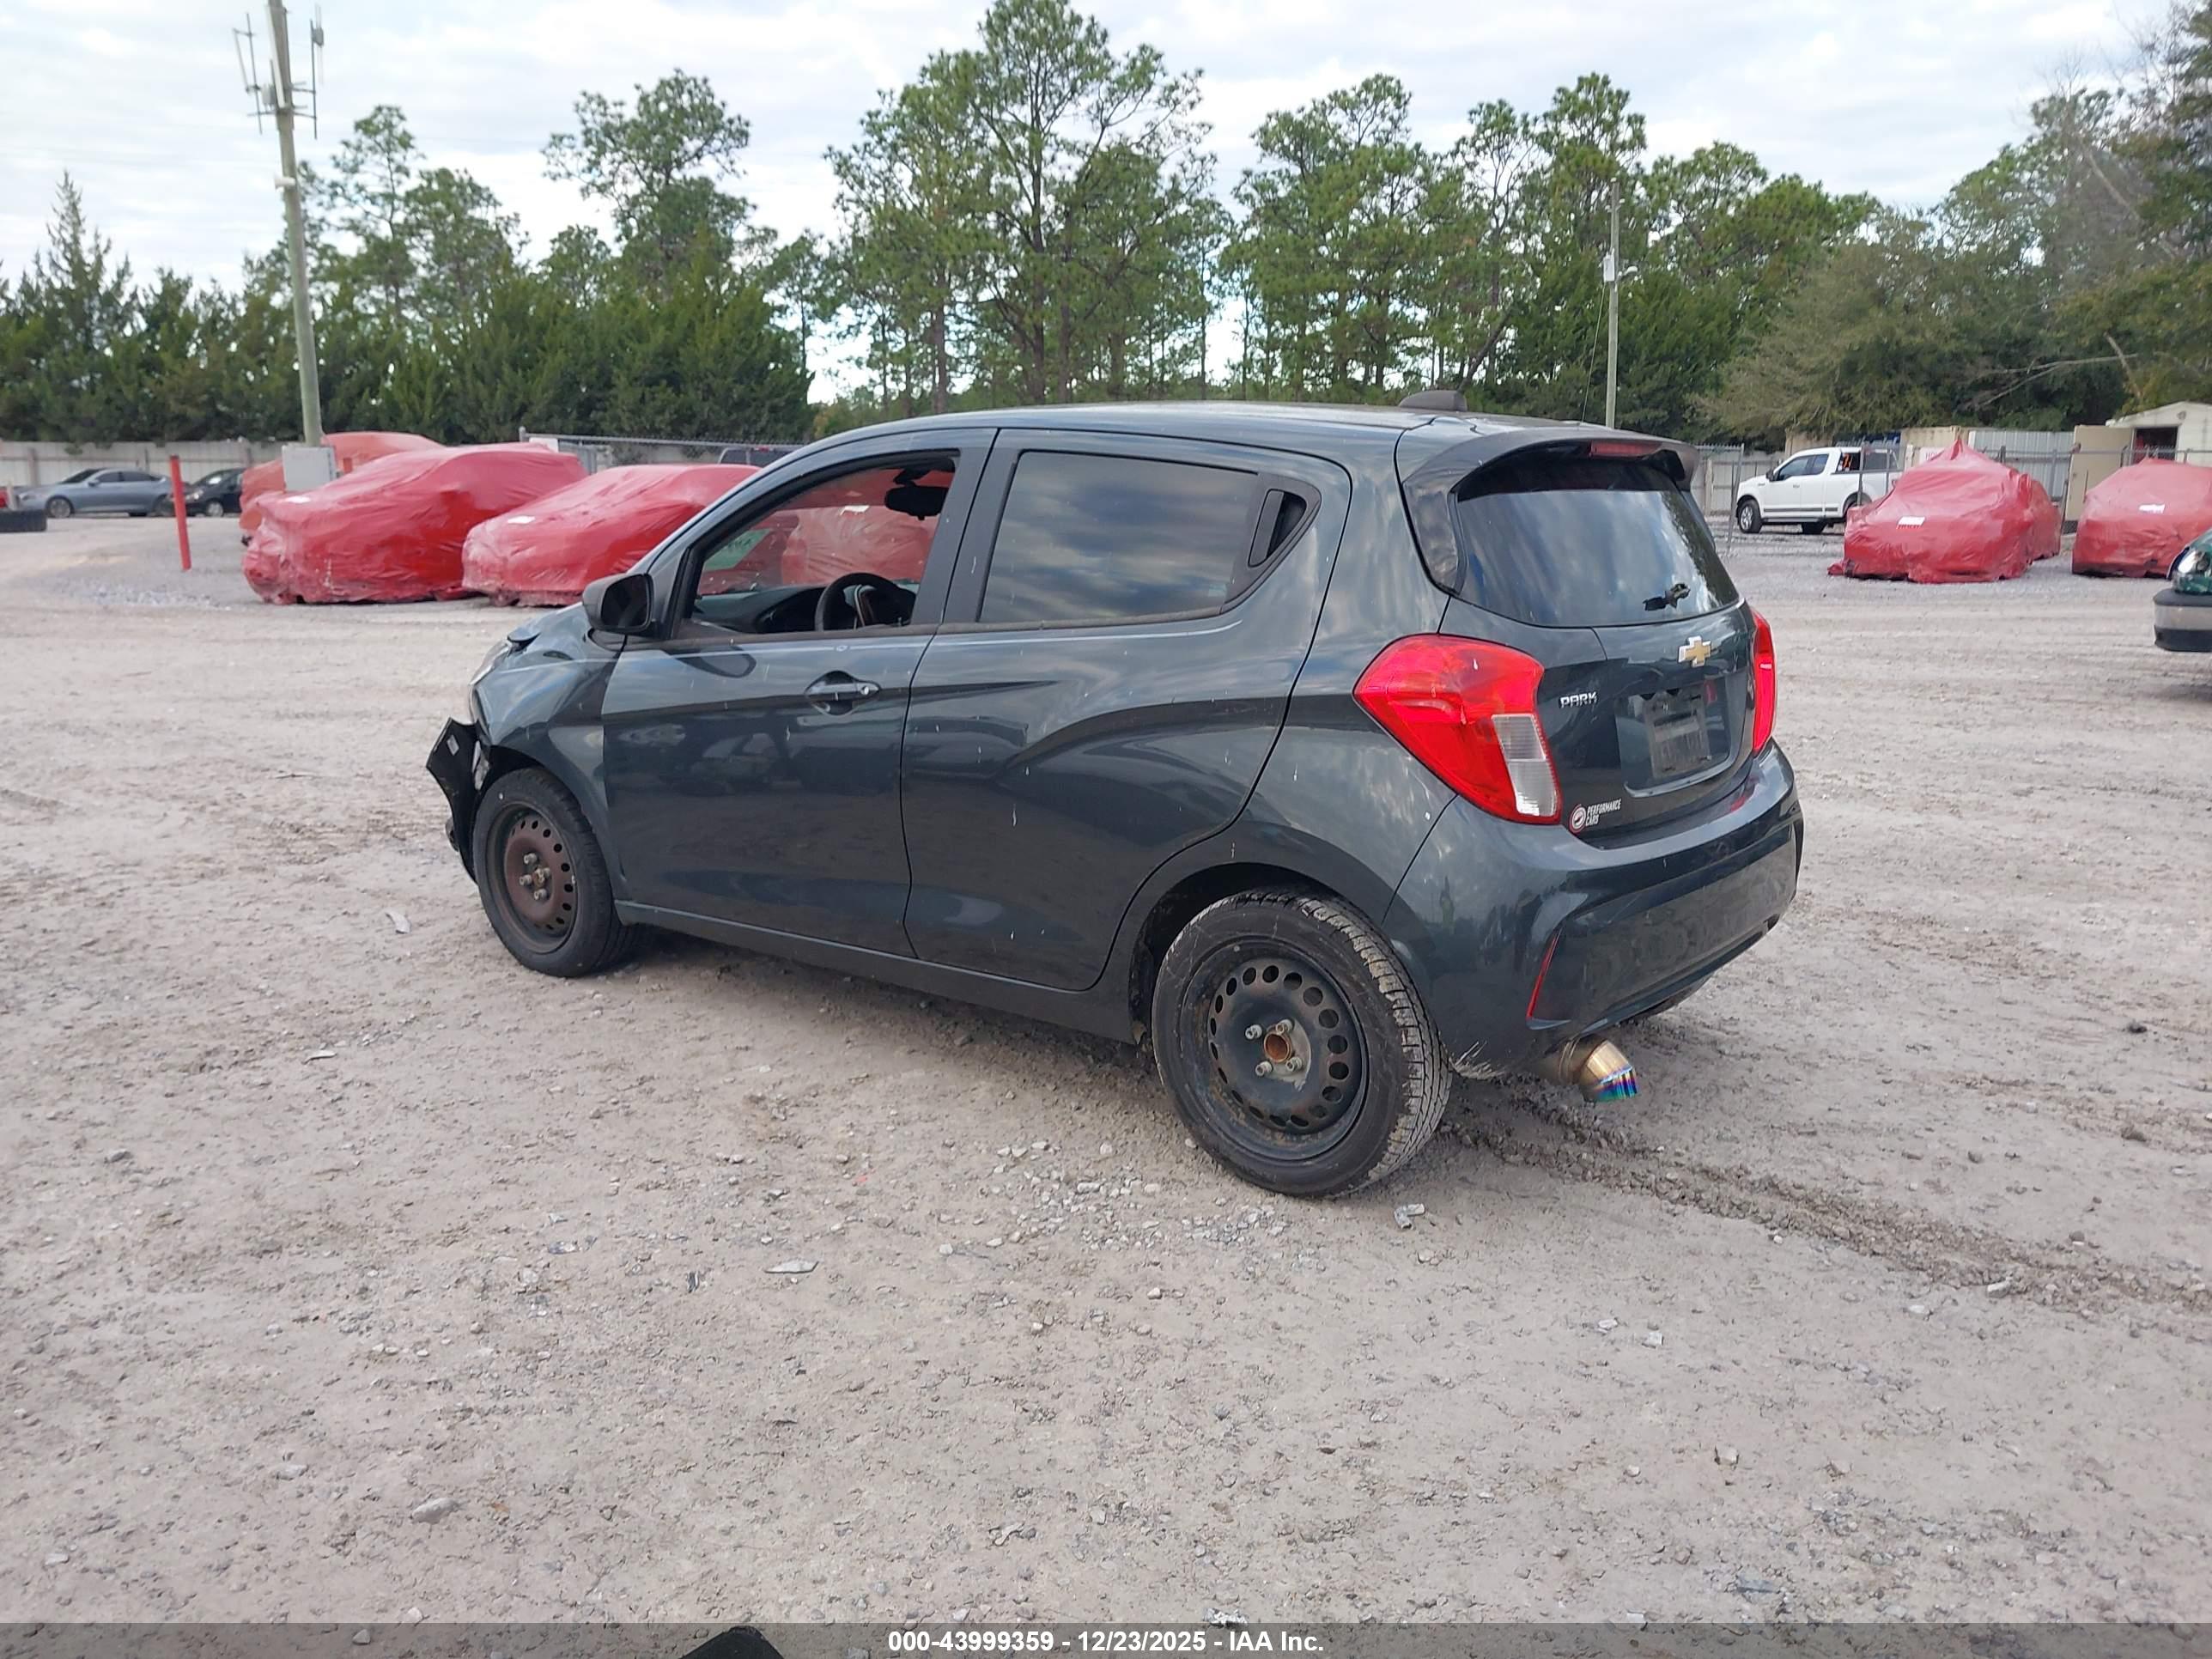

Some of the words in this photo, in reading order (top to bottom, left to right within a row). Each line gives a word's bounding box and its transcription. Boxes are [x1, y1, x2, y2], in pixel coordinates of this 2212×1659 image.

[1560, 690, 1597, 708] PARK
[1586, 798, 1622, 817] PERFORMANCE
[1585, 814, 1600, 827] CARS
